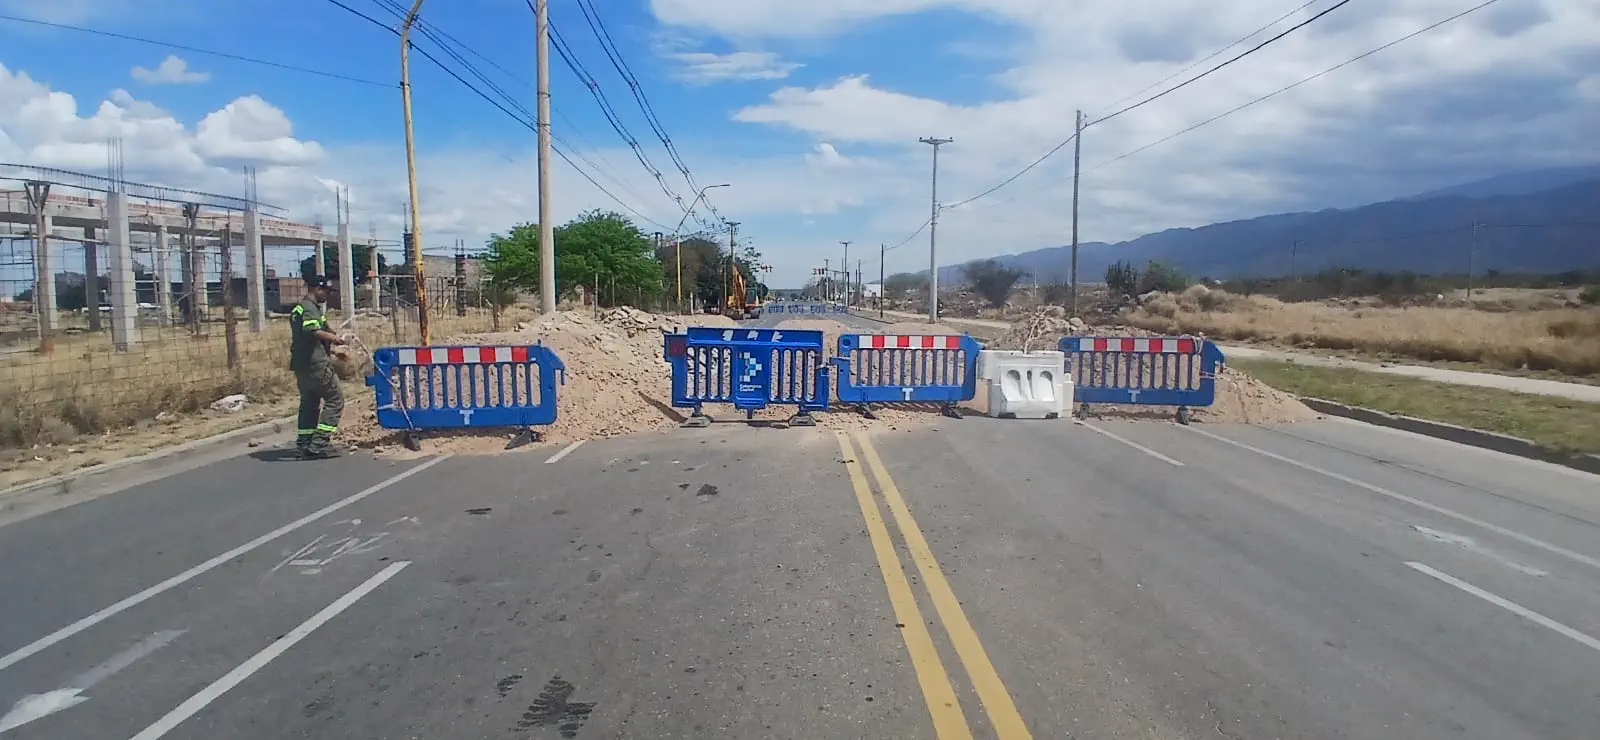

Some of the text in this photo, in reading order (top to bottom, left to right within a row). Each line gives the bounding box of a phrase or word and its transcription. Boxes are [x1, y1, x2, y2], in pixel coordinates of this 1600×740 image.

[901, 387, 914, 401] T
[1128, 389, 1141, 403] T
[459, 409, 475, 425] T
